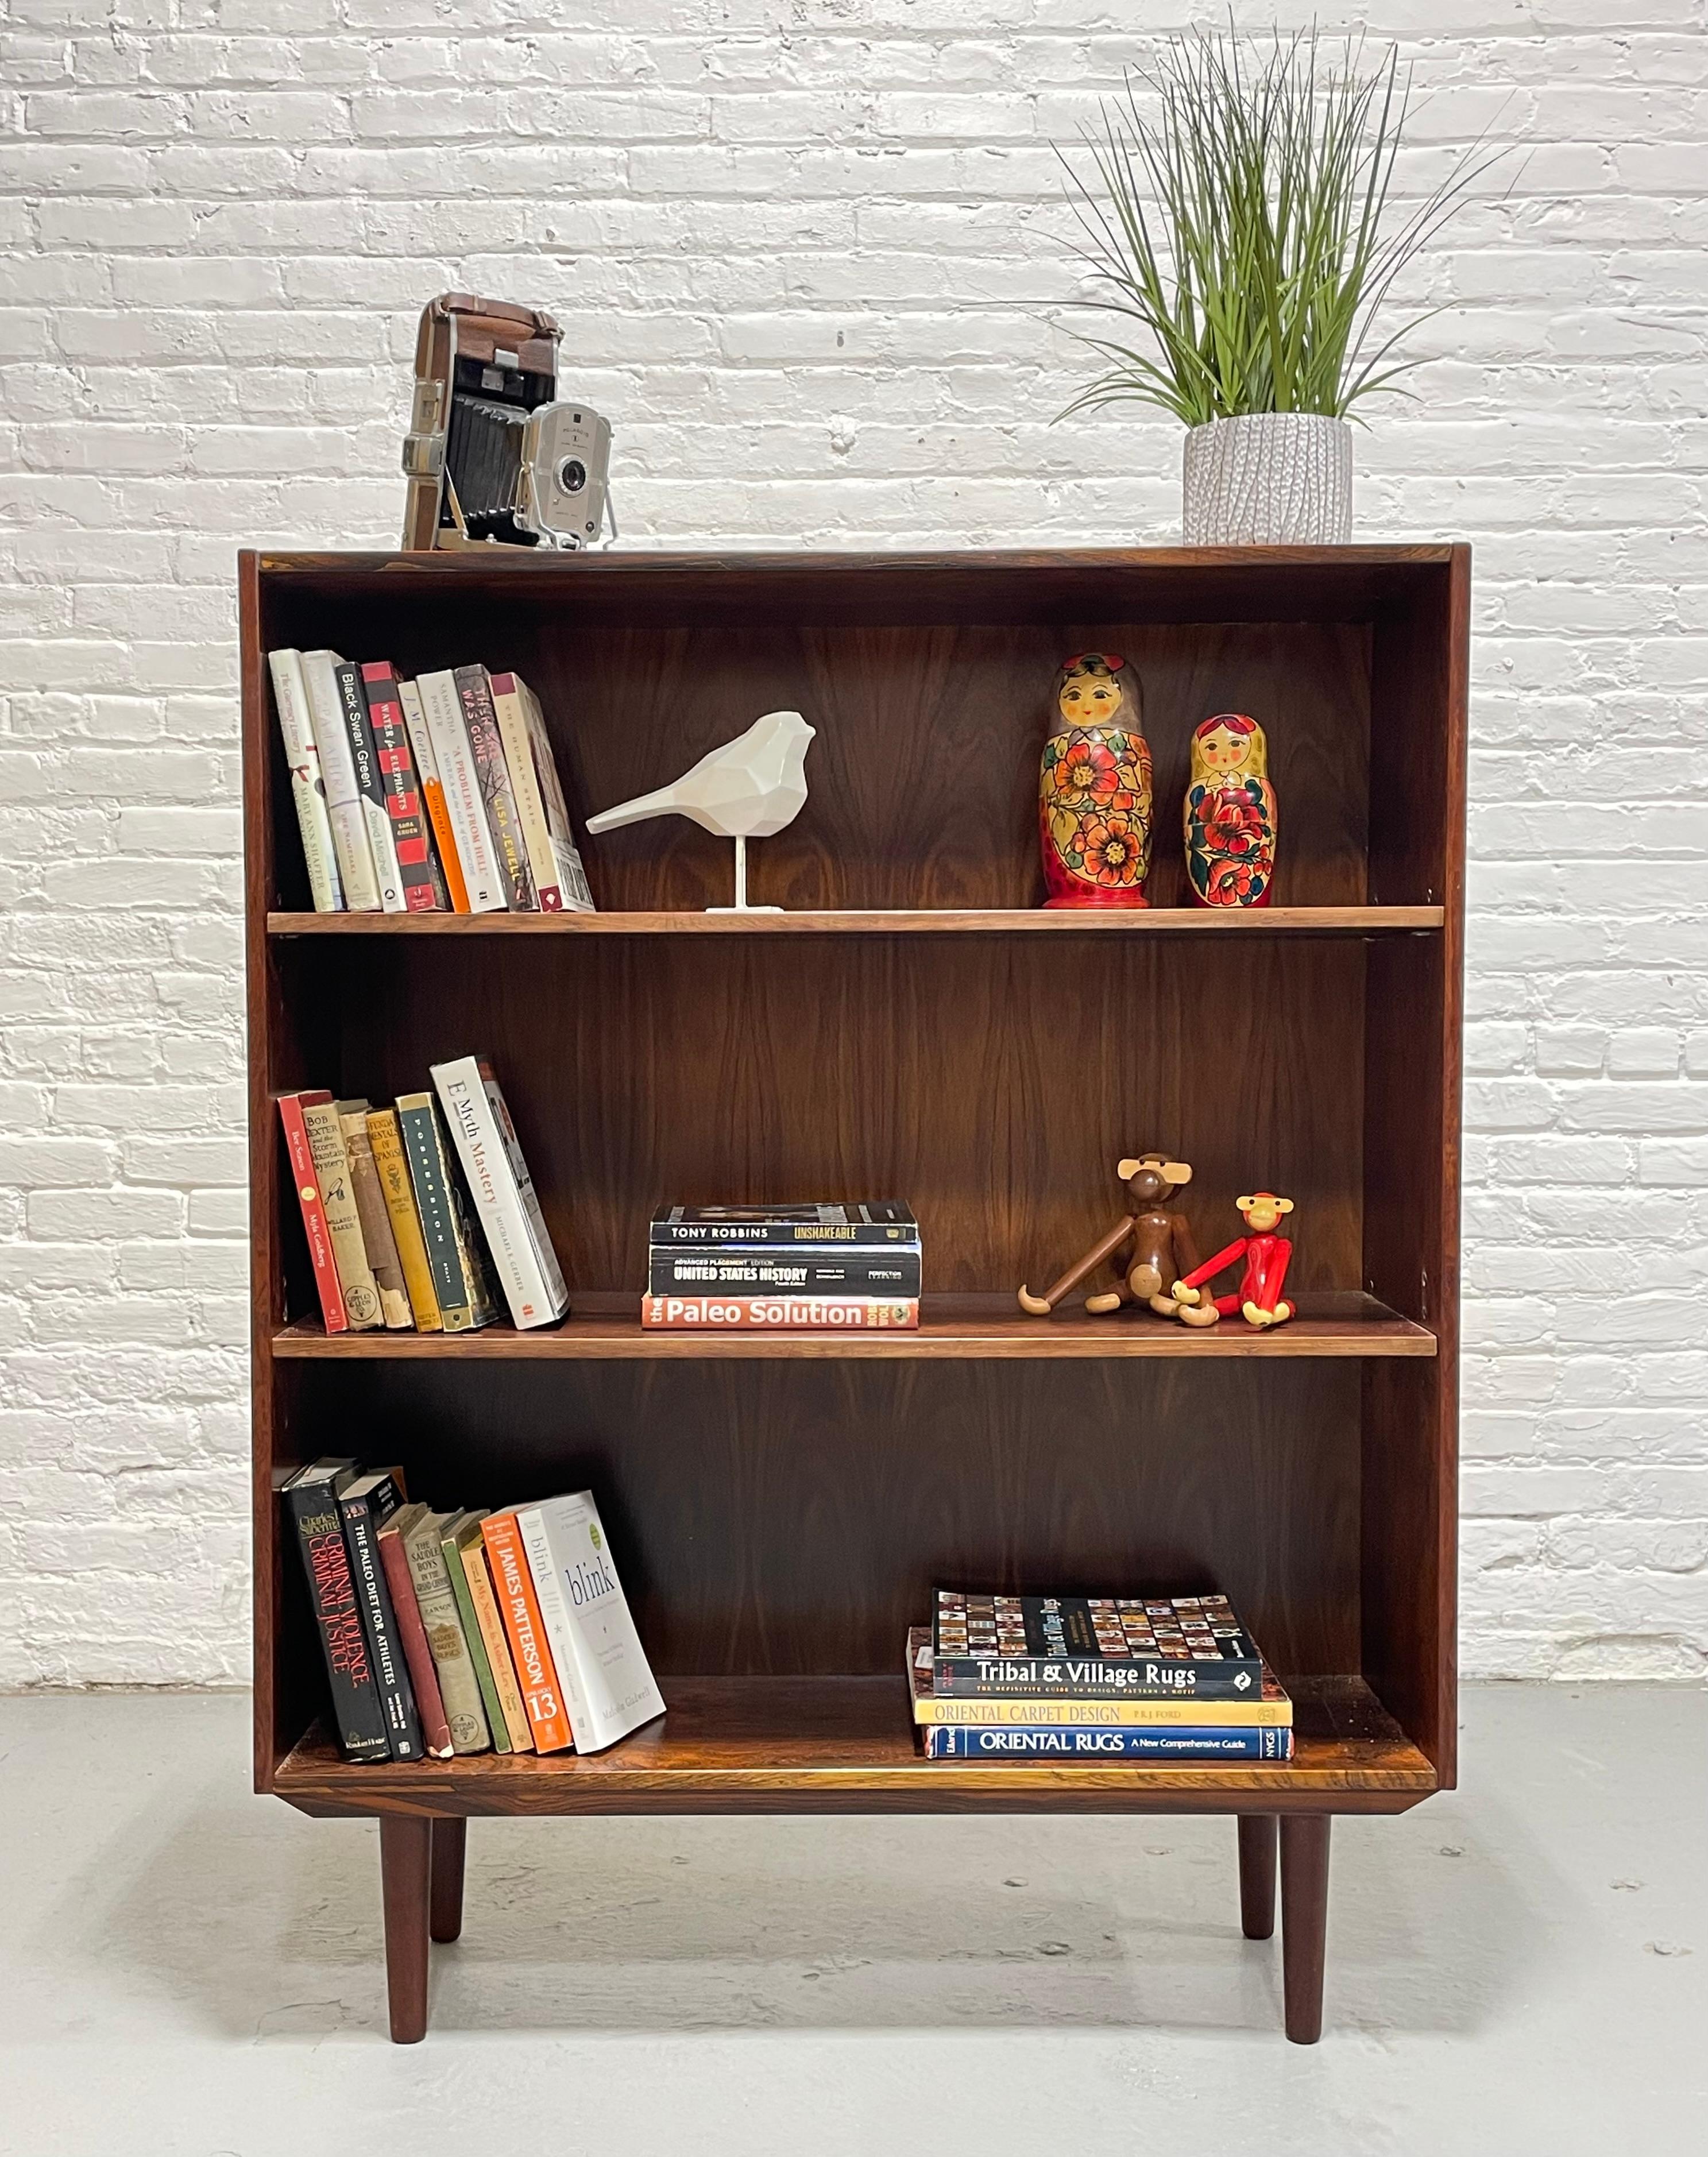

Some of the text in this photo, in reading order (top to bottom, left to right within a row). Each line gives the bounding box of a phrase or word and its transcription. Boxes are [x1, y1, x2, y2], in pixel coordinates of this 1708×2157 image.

[431, 695, 443, 726] POWER
[440, 683, 455, 734] SAMANTHA
[289, 724, 301, 753] Literary
[342, 673, 372, 788] Black Swan Green
[462, 690, 487, 763] WAS GONE
[381, 703, 394, 737] WATER
[390, 755, 408, 811] ELEPHANTS
[415, 730, 430, 770] Coetzee
[443, 752, 455, 787] AMERICA
[505, 705, 535, 825] THE HUMAN STAIN
[432, 795, 446, 835] Disgrace
[455, 760, 473, 812] PROBLEM
[467, 813, 481, 843] FROM
[300, 787, 325, 888] MARY ANN SHAFFER
[369, 810, 389, 877] David Mitchell
[494, 798, 520, 881] LISA JEWELL
[306, 1116, 328, 1126] BOB
[313, 1143, 338, 1152] Storm
[381, 1140, 391, 1149] OF
[447, 1080, 497, 1204] E Myth Mastery
[296, 1146, 305, 1171] Season
[310, 1215, 320, 1234] Myla
[332, 1223, 355, 1232] BAKER
[671, 1228, 768, 1238] TONY ROBBINS
[794, 1227, 856, 1240] UNSHAKEABLE
[496, 1216, 509, 1253] MICHAEL
[510, 1261, 524, 1291] GERBER
[674, 1266, 718, 1281] UNITED
[719, 1267, 758, 1281] STATES
[759, 1267, 807, 1281] HISTORY
[650, 1298, 663, 1322] the
[667, 1300, 861, 1324] Paleo Solution
[867, 1302, 878, 1326] ROB
[879, 1305, 888, 1326] WOL
[411, 1548, 439, 1562] SADDLE
[415, 1541, 430, 1551] THE
[531, 1536, 552, 1583] blink
[417, 1560, 438, 1571] BOYS
[565, 1556, 615, 1606] blink
[309, 1537, 350, 1674] CRIMINAL JUSTICE
[326, 1533, 369, 1688] CRIMINAL VIOLENCE
[354, 1524, 395, 1686] THE PALEO DIET FOR ATHLETES
[497, 1548, 523, 1596] JAMES
[511, 1598, 544, 1686] PATTERSON
[436, 1642, 456, 1650] BOYS
[483, 1602, 494, 1629] Name
[493, 1643, 506, 1670] Asher
[501, 1672, 509, 1688] Lev
[976, 1661, 1036, 1681] Tribal
[1043, 1665, 1062, 1682] &
[1066, 1663, 1138, 1687] Village
[1146, 1664, 1196, 1688] Rugs
[528, 1694, 557, 1722] 13
[935, 1705, 1120, 1722] ORIENTAL CARPET DESIGN
[1156, 1710, 1181, 1719] FORD
[979, 1732, 1246, 1751] ORIENTAL RUGS A New Comprehensive Guide
[1265, 1731, 1275, 1757] NYGS
